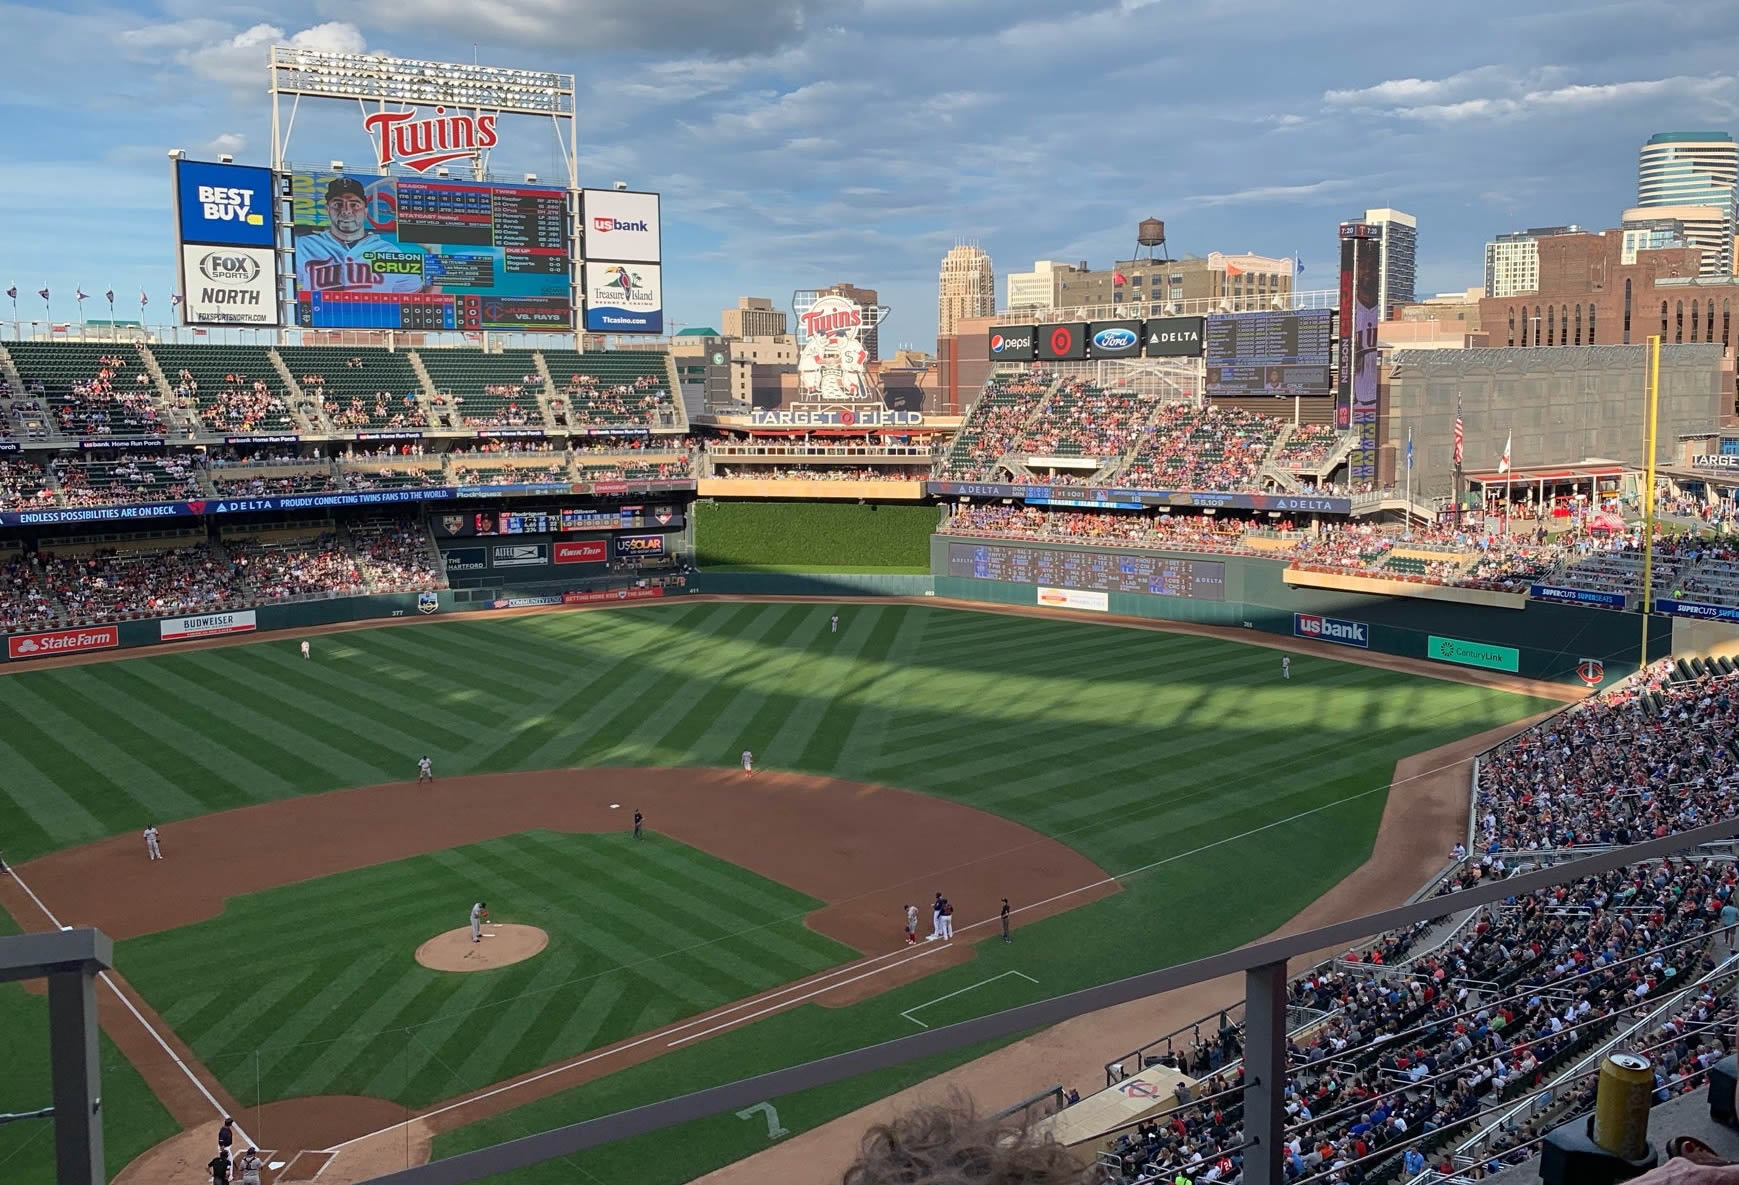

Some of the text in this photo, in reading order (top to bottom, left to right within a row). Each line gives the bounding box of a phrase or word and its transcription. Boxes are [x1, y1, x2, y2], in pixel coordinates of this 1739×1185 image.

[363, 106, 498, 167] Twins
[198, 185, 254, 206] BEST
[203, 203, 250, 222] BUY
[377, 252, 421, 260] NELSON
[212, 256, 247, 273] FOX
[374, 262, 422, 273] CRUZ
[212, 271, 249, 280] SPORTS
[201, 288, 260, 305] NORTH
[594, 287, 653, 301] Treasure Island
[198, 312, 267, 322] FOXSPORTSNORTH.COM
[801, 308, 862, 339] Twins
[1004, 336, 1030, 350] pepsi
[1102, 332, 1128, 347] Ford
[1161, 331, 1198, 342] DELTA
[1341, 338, 1349, 384] NELSON
[750, 411, 924, 425] TARGET FIELD
[1693, 455, 1738, 466] TARGE
[968, 486, 1000, 494] DELTA
[230, 490, 448, 510] DELTA PROUDLY CONNECTING TWINS FANS TO THE WORLD.
[1290, 500, 1332, 510] DELTA
[20, 512, 59, 523] ENDLESS
[60, 509, 119, 521] POSSIBILITIES
[121, 508, 137, 517] ARE
[154, 506, 176, 514] DECK.
[495, 548, 514, 557] ALTEC
[1542, 589, 1613, 603] SUPERCUTS SUPERSEATS
[1678, 604, 1717, 616] SUPERCUTS
[184, 615, 233, 628] BUDWEISER
[1456, 647, 1502, 662] CenturyLink
